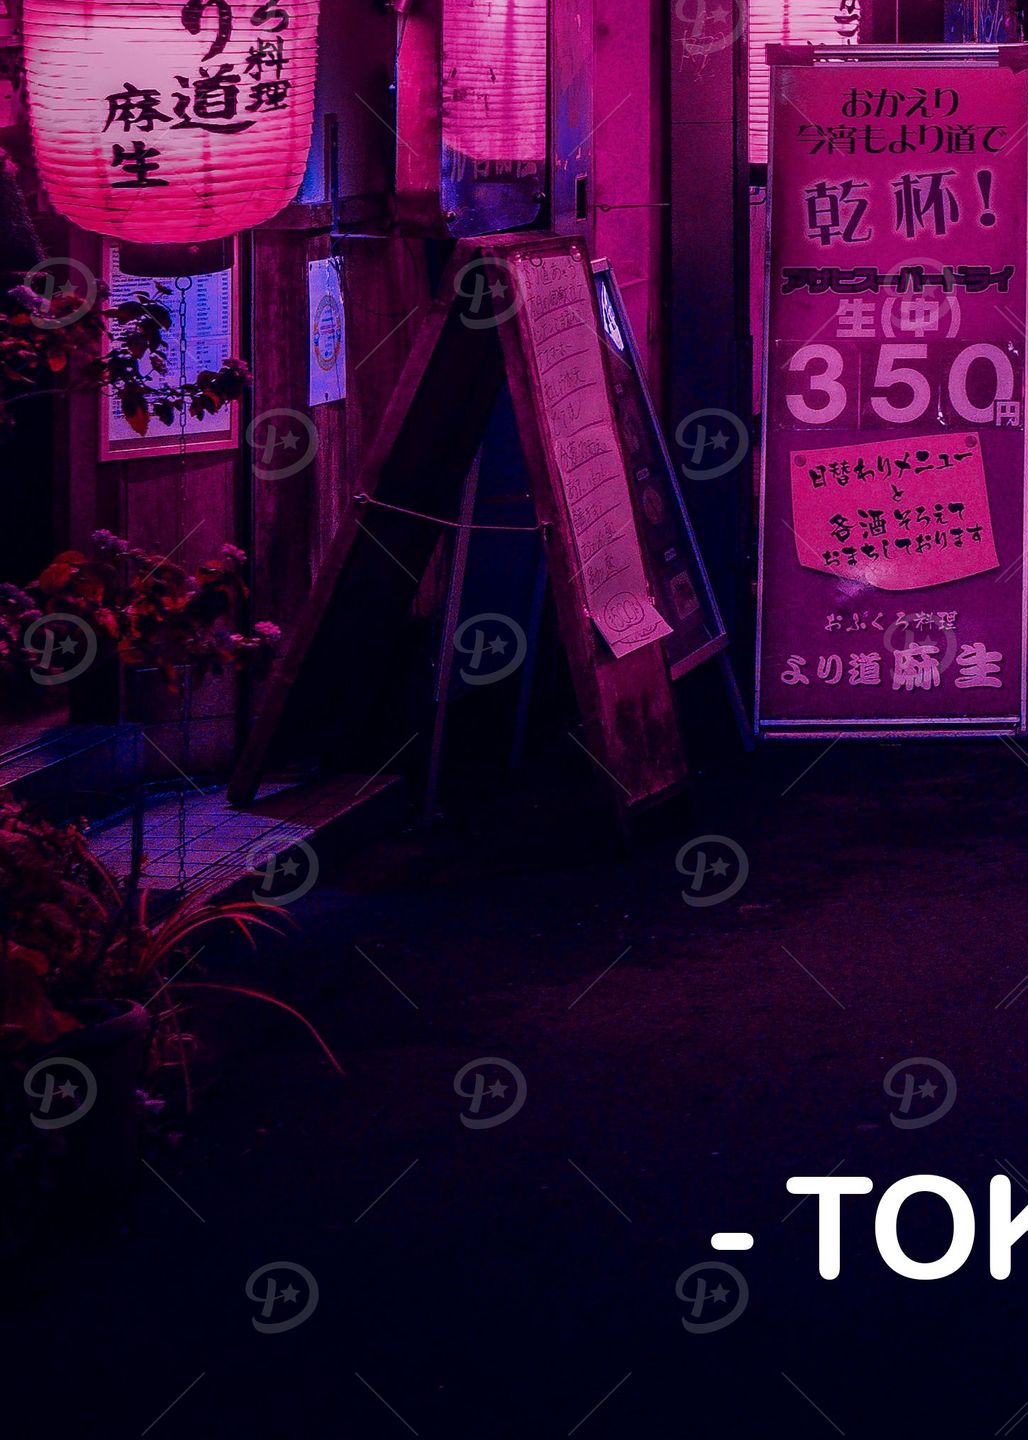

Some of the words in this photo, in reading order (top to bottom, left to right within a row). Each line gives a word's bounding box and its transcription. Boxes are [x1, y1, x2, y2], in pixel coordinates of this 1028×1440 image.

[841, 88, 960, 118] おかえり
[101, 82, 174, 189] 麻生
[798, 125, 1007, 155] 今宵もより道で
[809, 450, 975, 488] 日替わりメニュー
[891, 484, 904, 502] と
[822, 524, 984, 566] おまちしております
[823, 610, 959, 633] おふくろ料理
[780, 654, 883, 687] より道
[891, 642, 1004, 692] 麻生
